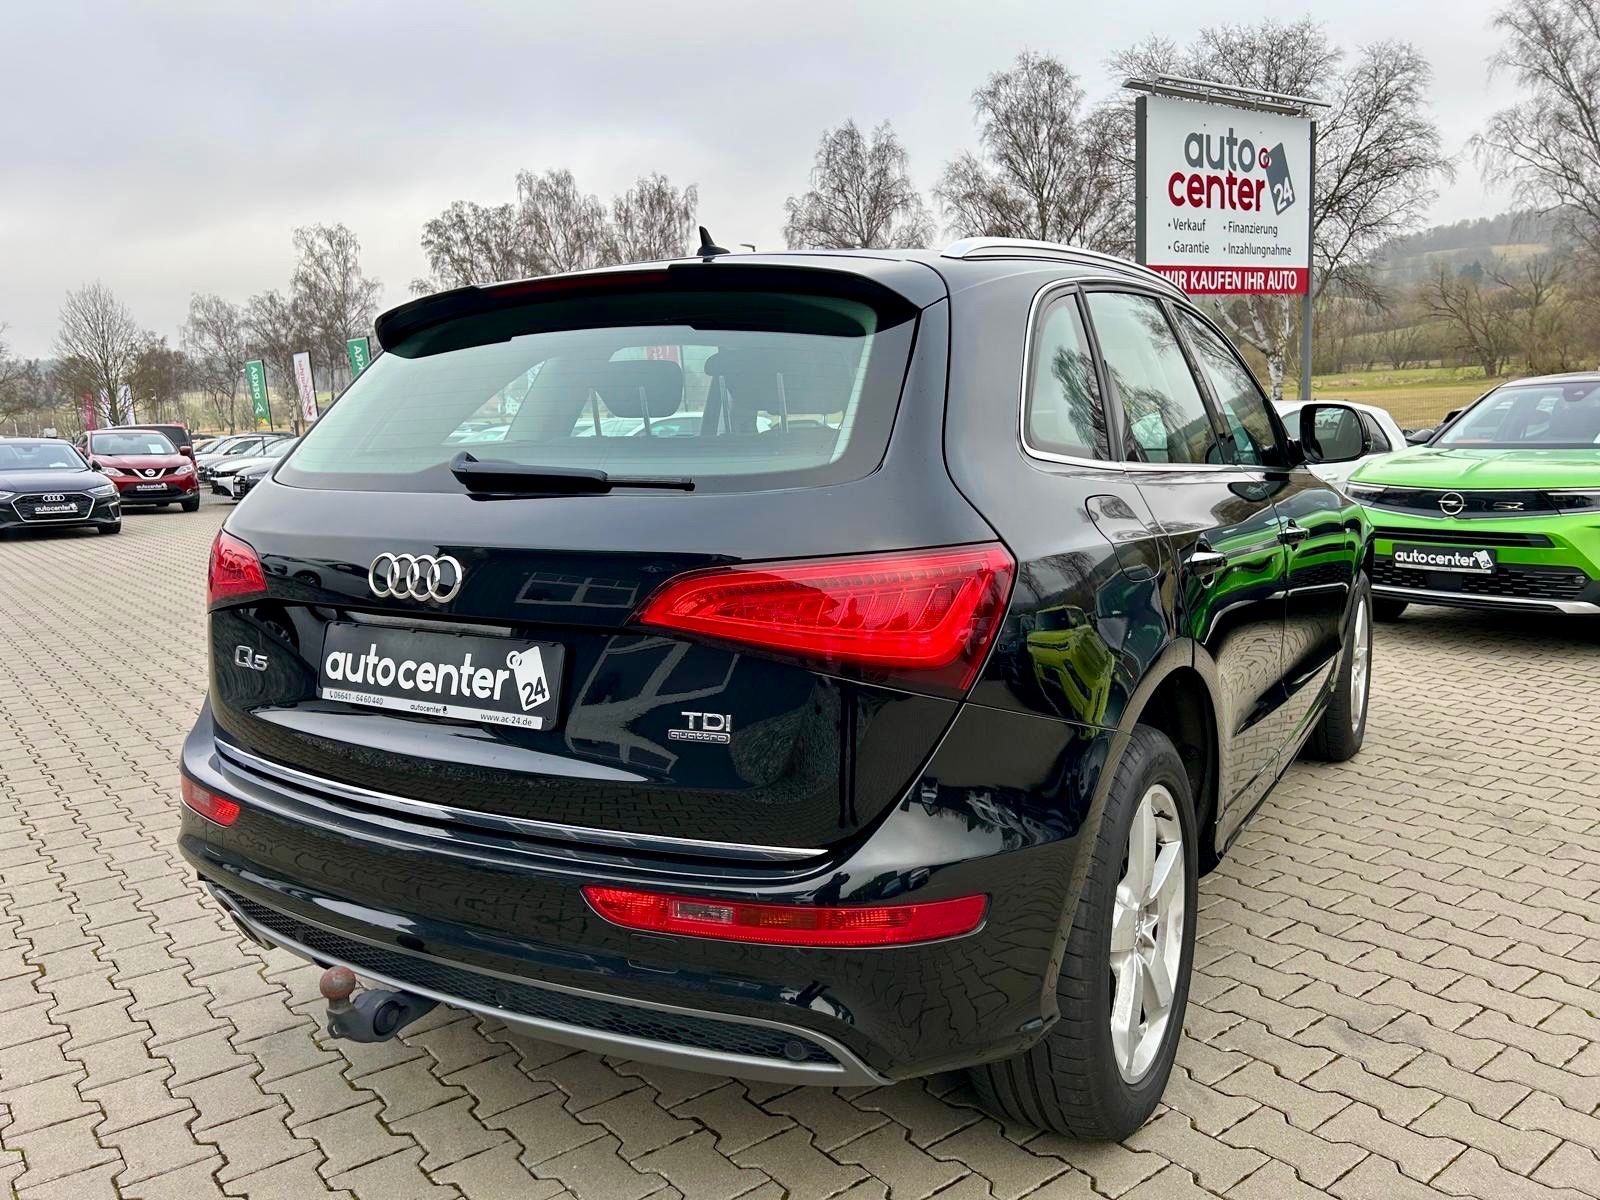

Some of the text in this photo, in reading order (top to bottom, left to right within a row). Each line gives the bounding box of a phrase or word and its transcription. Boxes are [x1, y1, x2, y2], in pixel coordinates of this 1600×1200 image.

[1184, 127, 1256, 171] auto
[1168, 169, 1266, 211] center
[1273, 176, 1294, 208] 24
[1173, 218, 1206, 232] Verkauf
[1228, 220, 1278, 238] Finanzierung
[1173, 241, 1210, 254] Garantie
[1228, 243, 1292, 259] Inzahlungnahme
[1159, 270, 1298, 290] WIR KAUFEN IHR AUTO
[1394, 549, 1477, 567] autocenter
[234, 644, 269, 672] Q5
[324, 643, 511, 701] autocenter
[521, 677, 547, 707] 24
[409, 703, 442, 715] autocenter
[479, 712, 533, 727] www.ac-24.de
[680, 711, 732, 732] TDI
[669, 730, 728, 743] quattro
